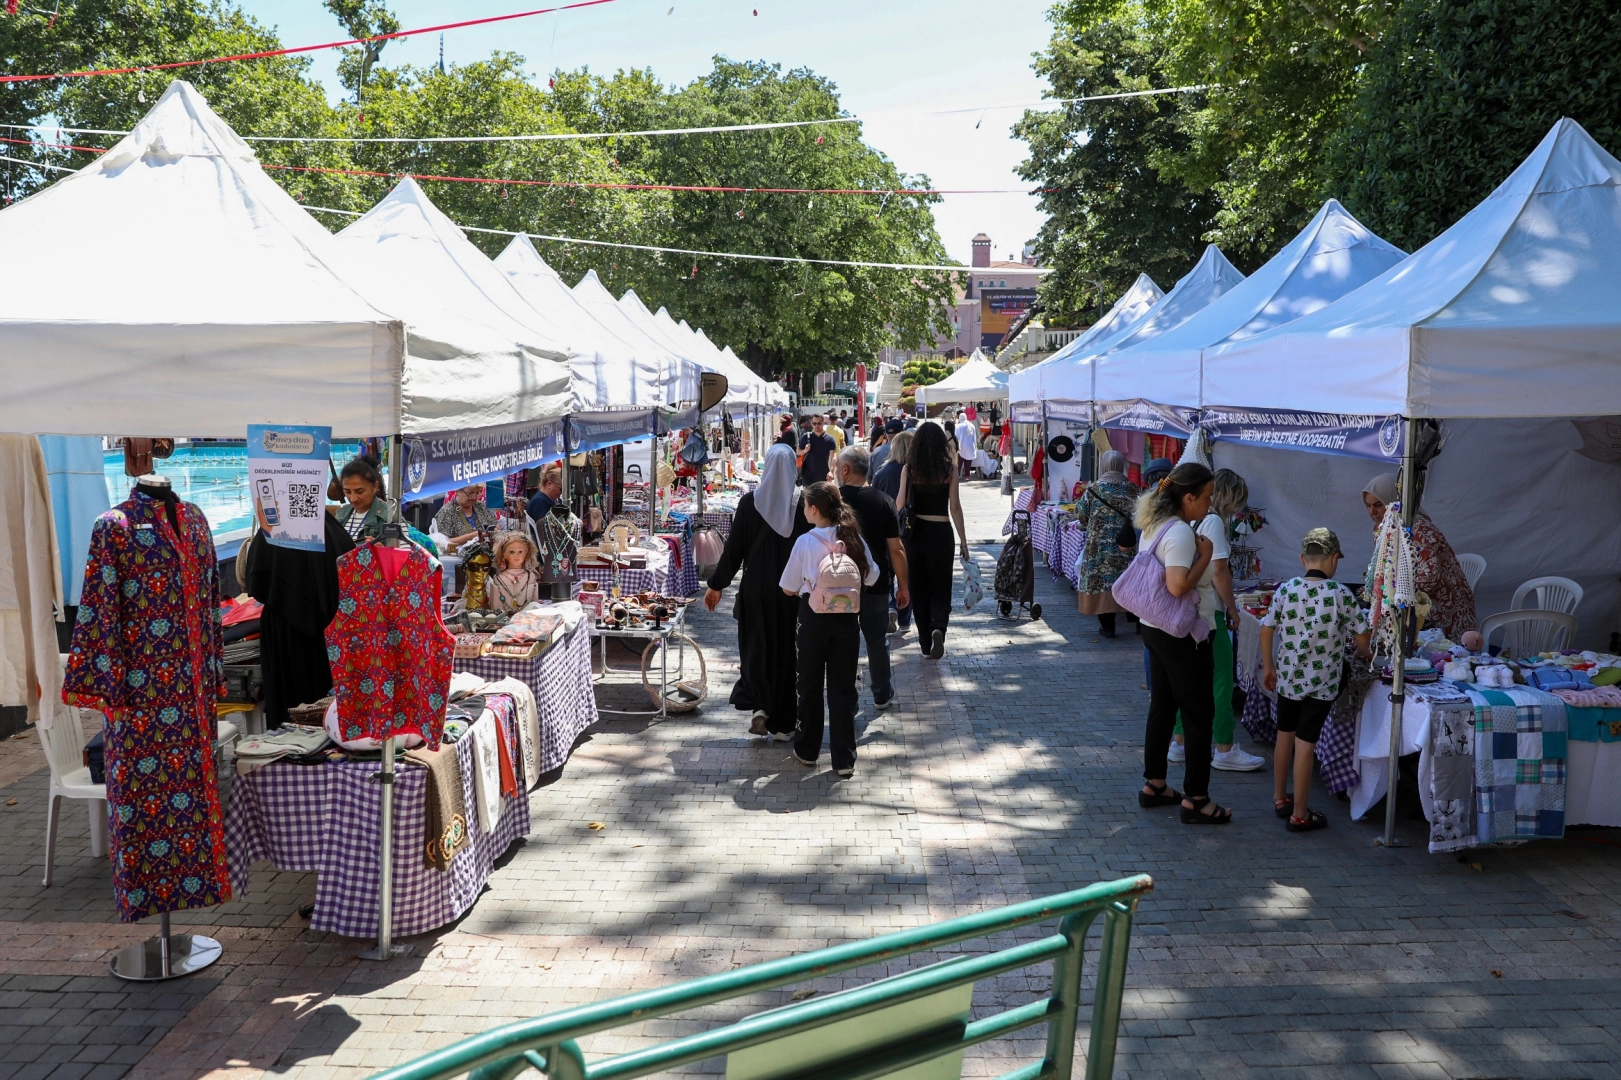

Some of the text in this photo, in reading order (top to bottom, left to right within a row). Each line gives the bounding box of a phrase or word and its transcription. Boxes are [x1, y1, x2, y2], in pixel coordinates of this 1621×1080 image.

[1218, 412, 1228, 424] S.S.
[1228, 412, 1252, 425] BURSA
[1250, 413, 1272, 425] ESNAF
[1270, 414, 1312, 426] KADINLARI
[1311, 414, 1339, 427] KADIN
[276, 436, 310, 444] meydan
[432, 440, 446, 458] S.S.
[446, 431, 480, 458] GÜLÇİÇEK
[480, 432, 501, 450] HATUN
[1240, 426, 1348, 450] ÜRETİM VE İŞLETME KOOPERATİFİ
[452, 462, 462, 482] VE
[463, 458, 490, 483] İŞLETME
[526, 442, 543, 462] BİRLİĞİ
